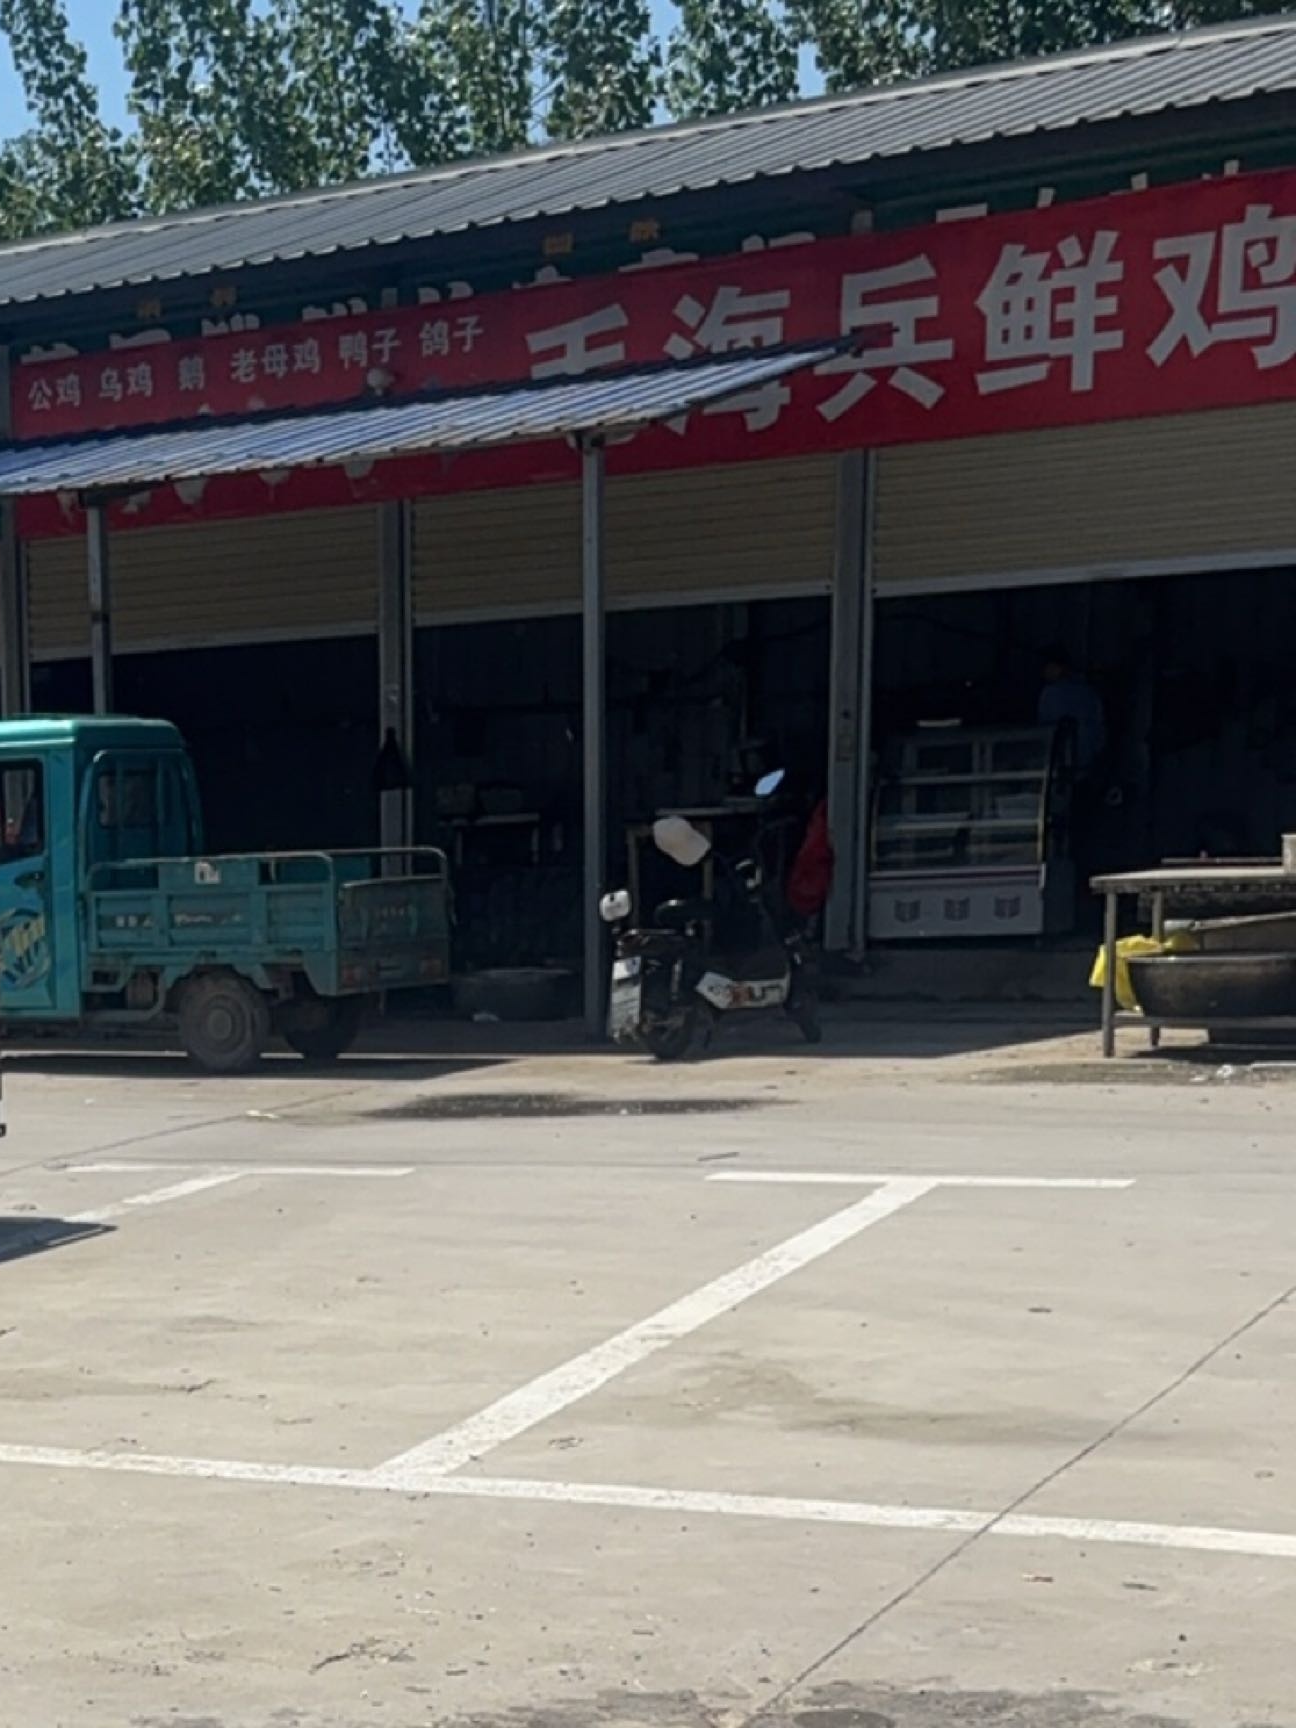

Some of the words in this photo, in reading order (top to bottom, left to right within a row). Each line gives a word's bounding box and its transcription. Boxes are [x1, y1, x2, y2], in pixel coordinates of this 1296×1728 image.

[27, 372, 81, 411] 公鸡
[99, 362, 153, 402] 乌鸡
[229, 339, 322, 383] 老母鸡
[338, 329, 402, 369] 鸭子
[419, 315, 484, 357] 鸽子
